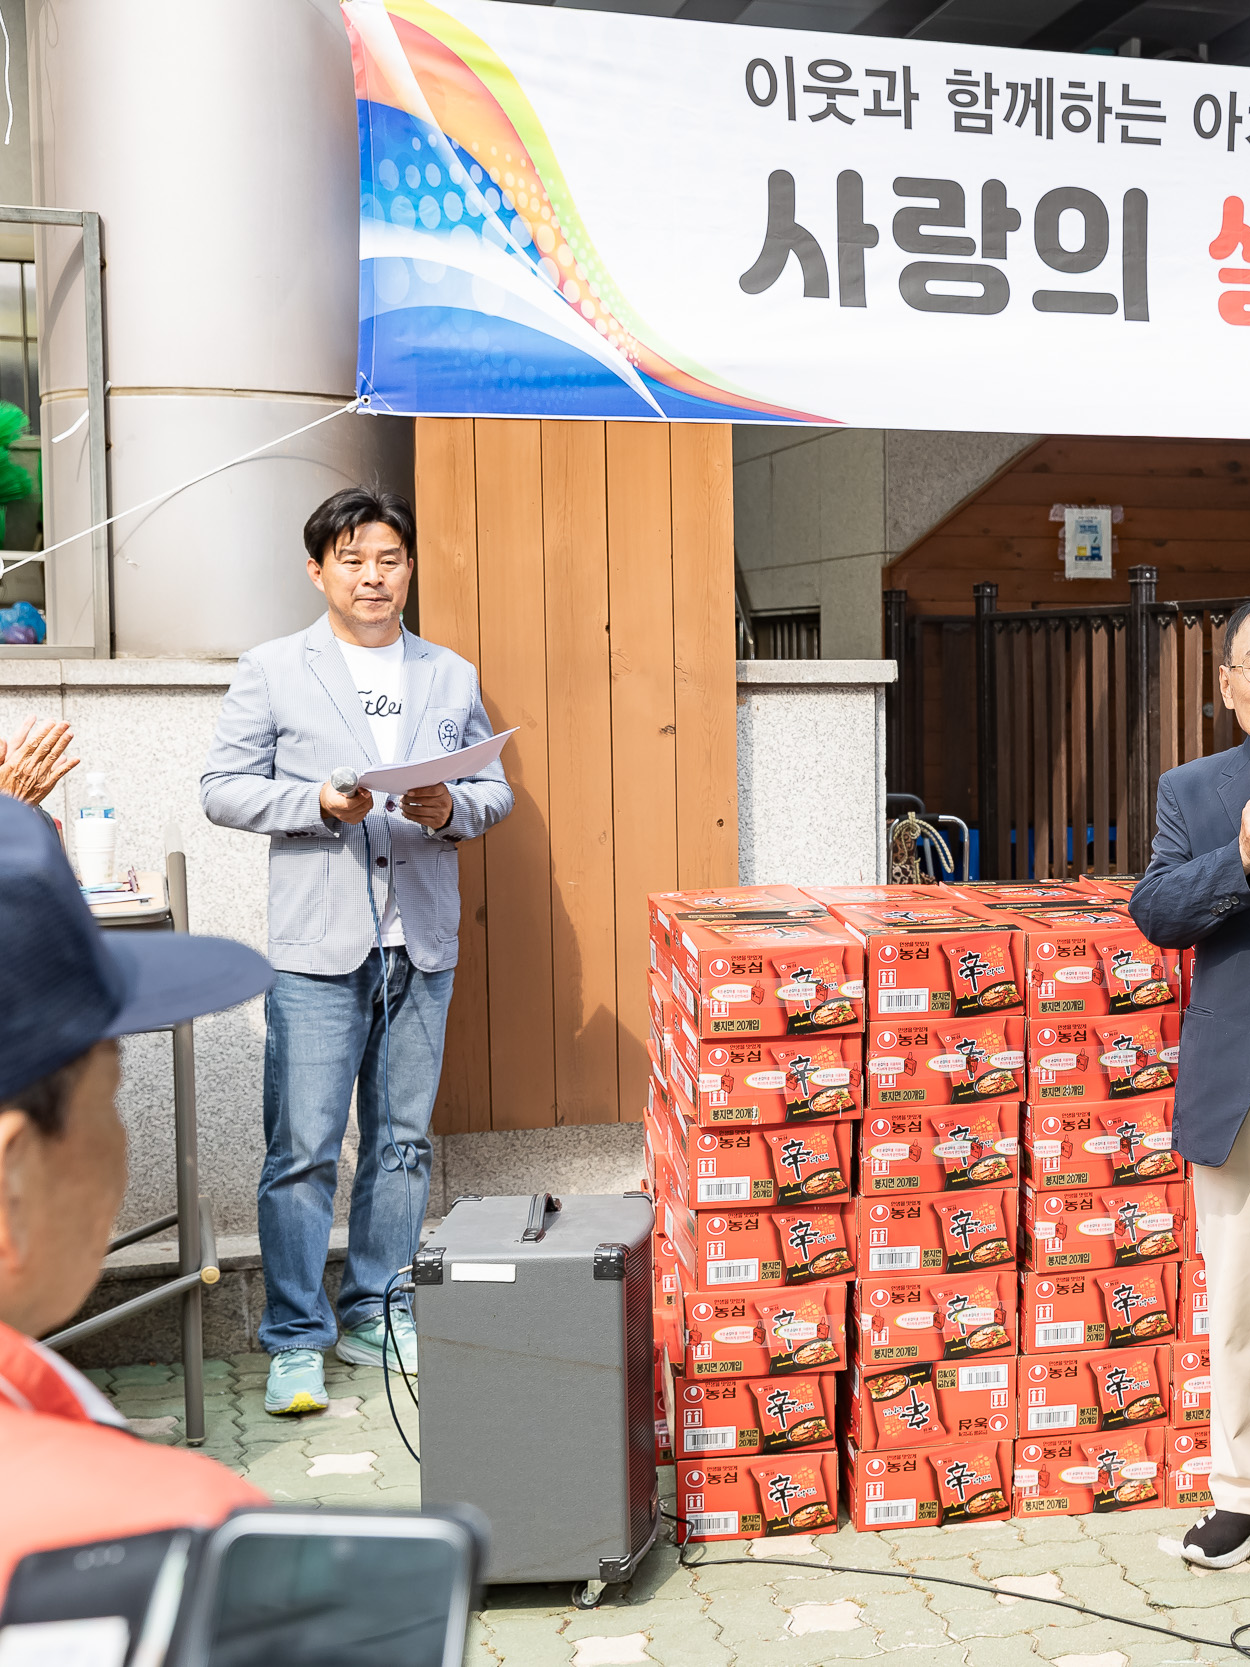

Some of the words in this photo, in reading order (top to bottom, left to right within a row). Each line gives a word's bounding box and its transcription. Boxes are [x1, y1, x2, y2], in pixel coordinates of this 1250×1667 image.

[745, 55, 919, 130] 이웃과
[946, 69, 1166, 145] 함께하는
[739, 169, 1149, 322] 사랑의
[900, 948, 930, 960] 농심
[1057, 945, 1086, 957] 농심
[731, 962, 763, 974] 농심
[932, 992, 950, 1000] 봉지면
[1041, 1002, 1061, 1012] 봉지면
[1062, 1001, 1084, 1010] 20개입
[713, 1020, 734, 1031] 봉지면
[737, 1020, 760, 1030] 20개입
[898, 1033, 928, 1046] 농심
[1058, 1031, 1087, 1042] 농심
[730, 1050, 761, 1063] 농심
[881, 1091, 901, 1101] 봉지면
[903, 1090, 925, 1100] 20개입
[1041, 1087, 1061, 1097] 봉지면
[712, 1109, 734, 1120] 봉지면
[892, 1122, 922, 1133] 농심
[1063, 1118, 1091, 1131] 농심
[719, 1136, 750, 1148] 농심
[753, 1180, 772, 1189] 봉지면
[875, 1178, 895, 1188] 봉지면
[897, 1177, 919, 1186] 20개입
[1046, 1175, 1065, 1185] 봉지면
[1067, 1174, 1088, 1184] 20개입
[753, 1189, 772, 1198] 20개입
[1064, 1199, 1093, 1211] 농심
[891, 1207, 921, 1219] 농심
[728, 1219, 758, 1231] 농심
[923, 1250, 941, 1258] 봉지면
[1048, 1255, 1068, 1265] 봉지면
[1069, 1253, 1090, 1263] 20개입
[762, 1261, 781, 1270] 봉지면
[923, 1259, 941, 1267] 20개입
[761, 1270, 780, 1279] 20개입
[1056, 1282, 1085, 1295] 농심
[891, 1292, 921, 1304] 농심
[715, 1305, 745, 1318] 농심
[1087, 1324, 1104, 1332] 봉지면
[1087, 1333, 1104, 1341] 20개입
[874, 1349, 894, 1358] 봉지면
[896, 1347, 917, 1357] 20개입
[697, 1362, 718, 1373] 봉지면
[720, 1361, 742, 1371] 20개입
[1049, 1366, 1078, 1378] 농심
[938, 1380, 956, 1388] 봉지면
[706, 1387, 736, 1400] 농심
[1185, 1410, 1205, 1420] 봉지면
[959, 1418, 988, 1430] 농심
[1079, 1417, 1097, 1425] 20개입
[739, 1430, 758, 1438] 봉지면
[739, 1438, 758, 1447] 20개입
[1043, 1446, 1072, 1459] 농심
[887, 1460, 916, 1473] 농심
[708, 1472, 738, 1484] 농심
[1179, 1494, 1198, 1503] 봉지면
[919, 1502, 938, 1510] 봉지면
[1025, 1500, 1045, 1510] 봉지면
[1047, 1499, 1068, 1509] 20개입
[742, 1515, 760, 1523] 봉지면
[919, 1511, 937, 1519] 20개입
[741, 1523, 760, 1532] 20개입
